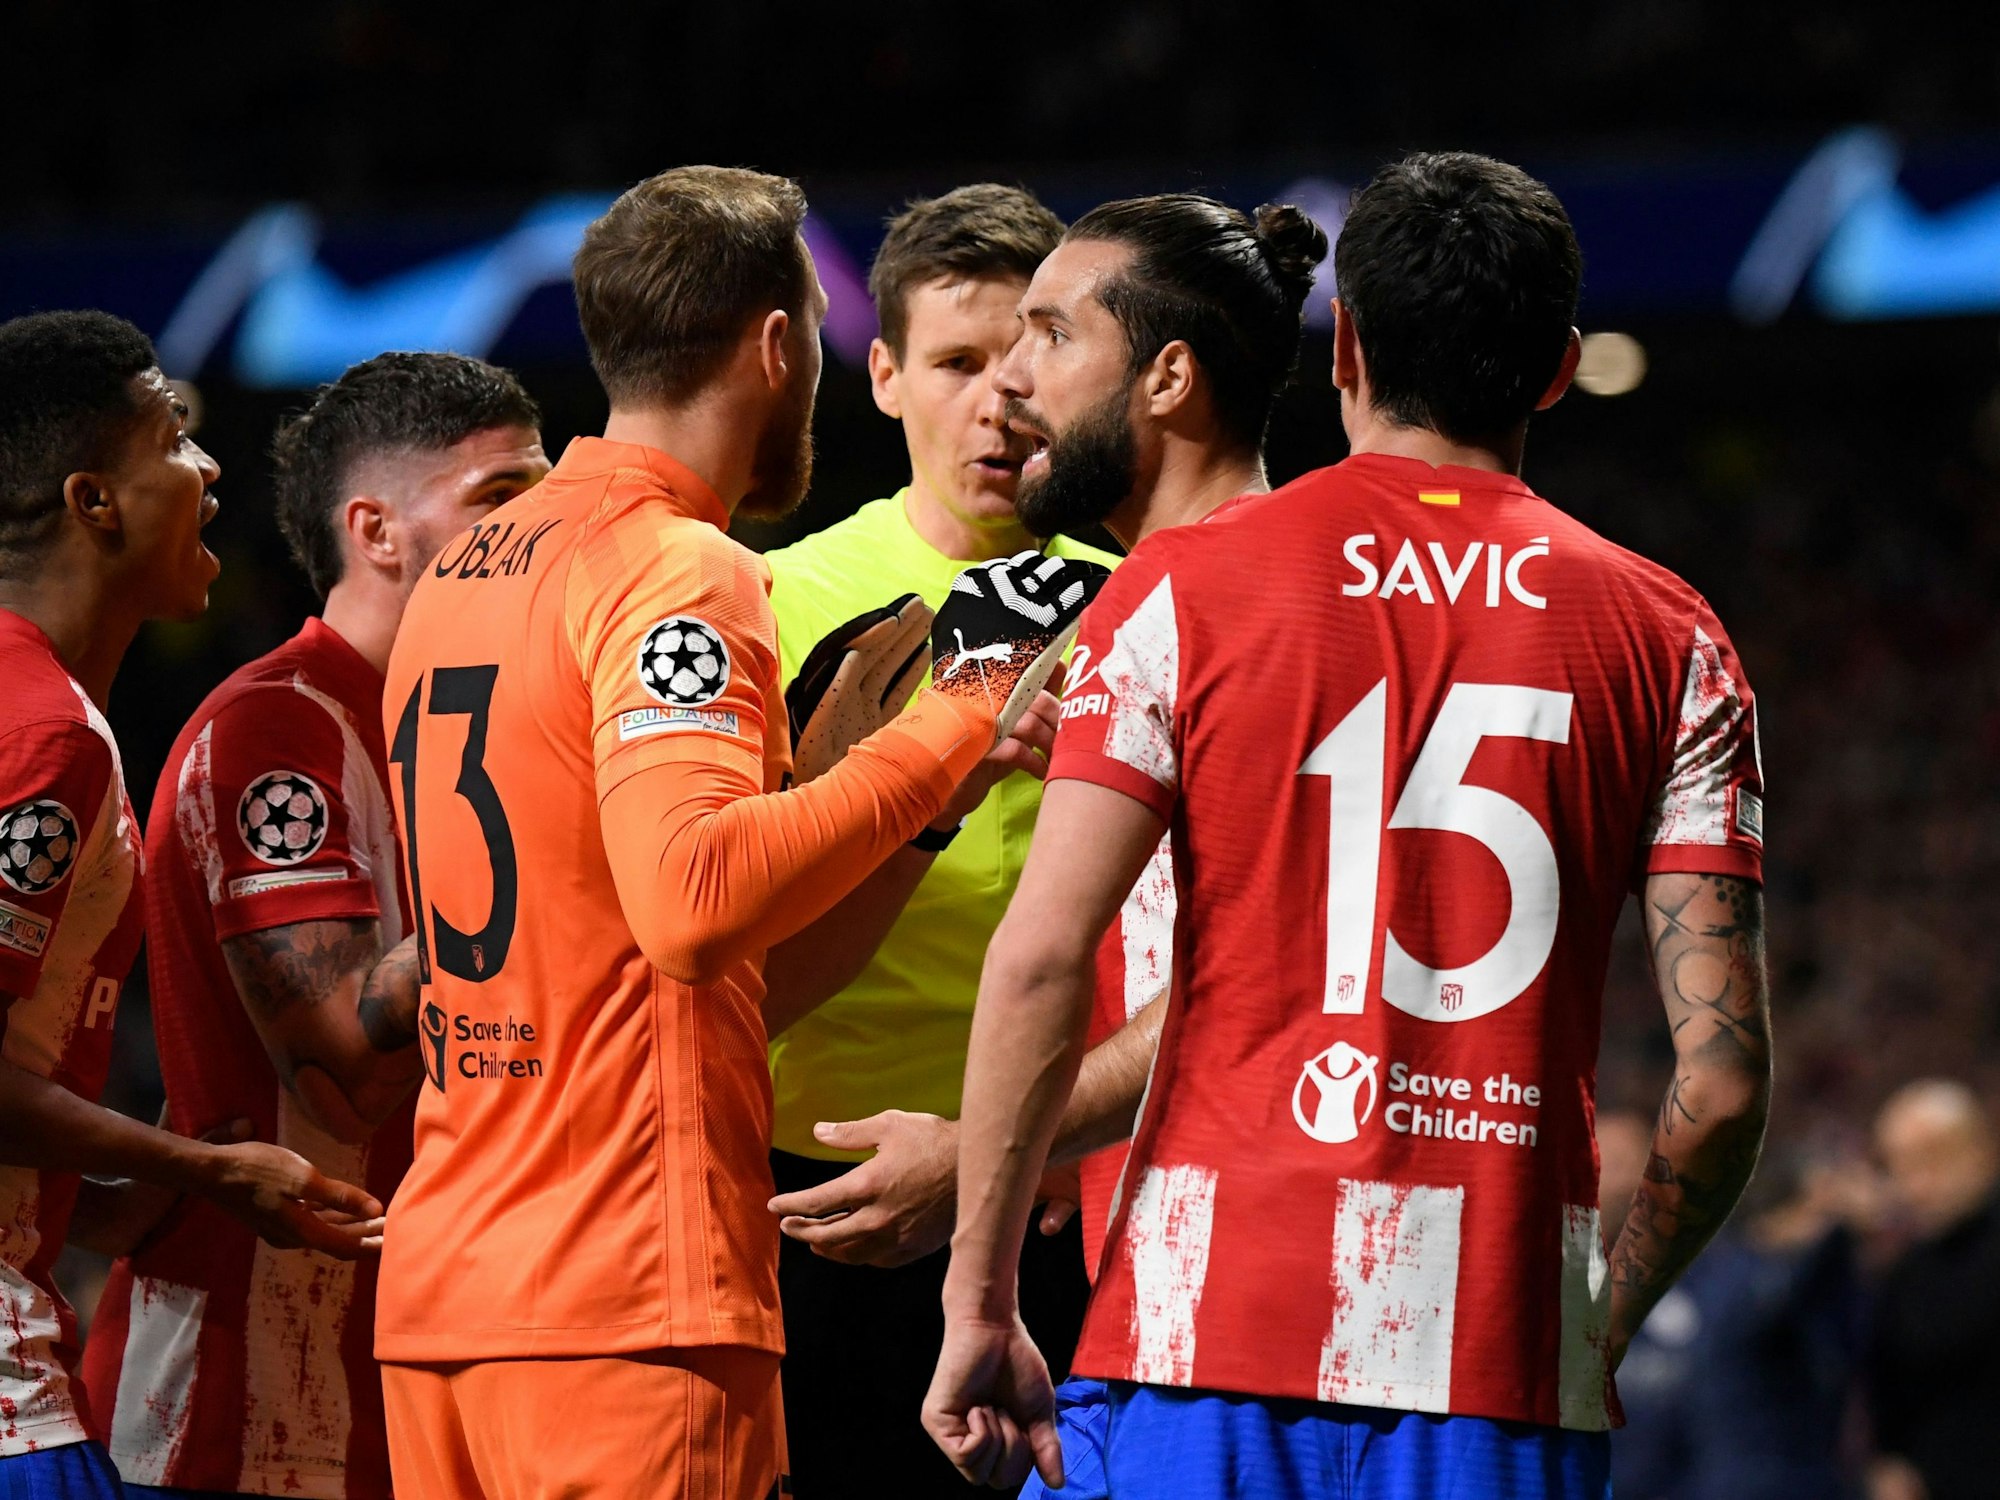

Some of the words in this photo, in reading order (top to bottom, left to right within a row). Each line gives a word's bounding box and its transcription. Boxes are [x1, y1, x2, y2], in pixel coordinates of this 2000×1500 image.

[435, 519, 565, 580] OBLAK
[1341, 533, 1550, 610] SAVIĆ
[622, 706, 737, 728] FOUNDATION
[388, 664, 518, 985] 13
[1294, 675, 1574, 1024] 15
[453, 1014, 502, 1042] Save
[1387, 1062, 1472, 1101] Save
[1482, 1072, 1542, 1108] the
[1383, 1101, 1539, 1148] Children
